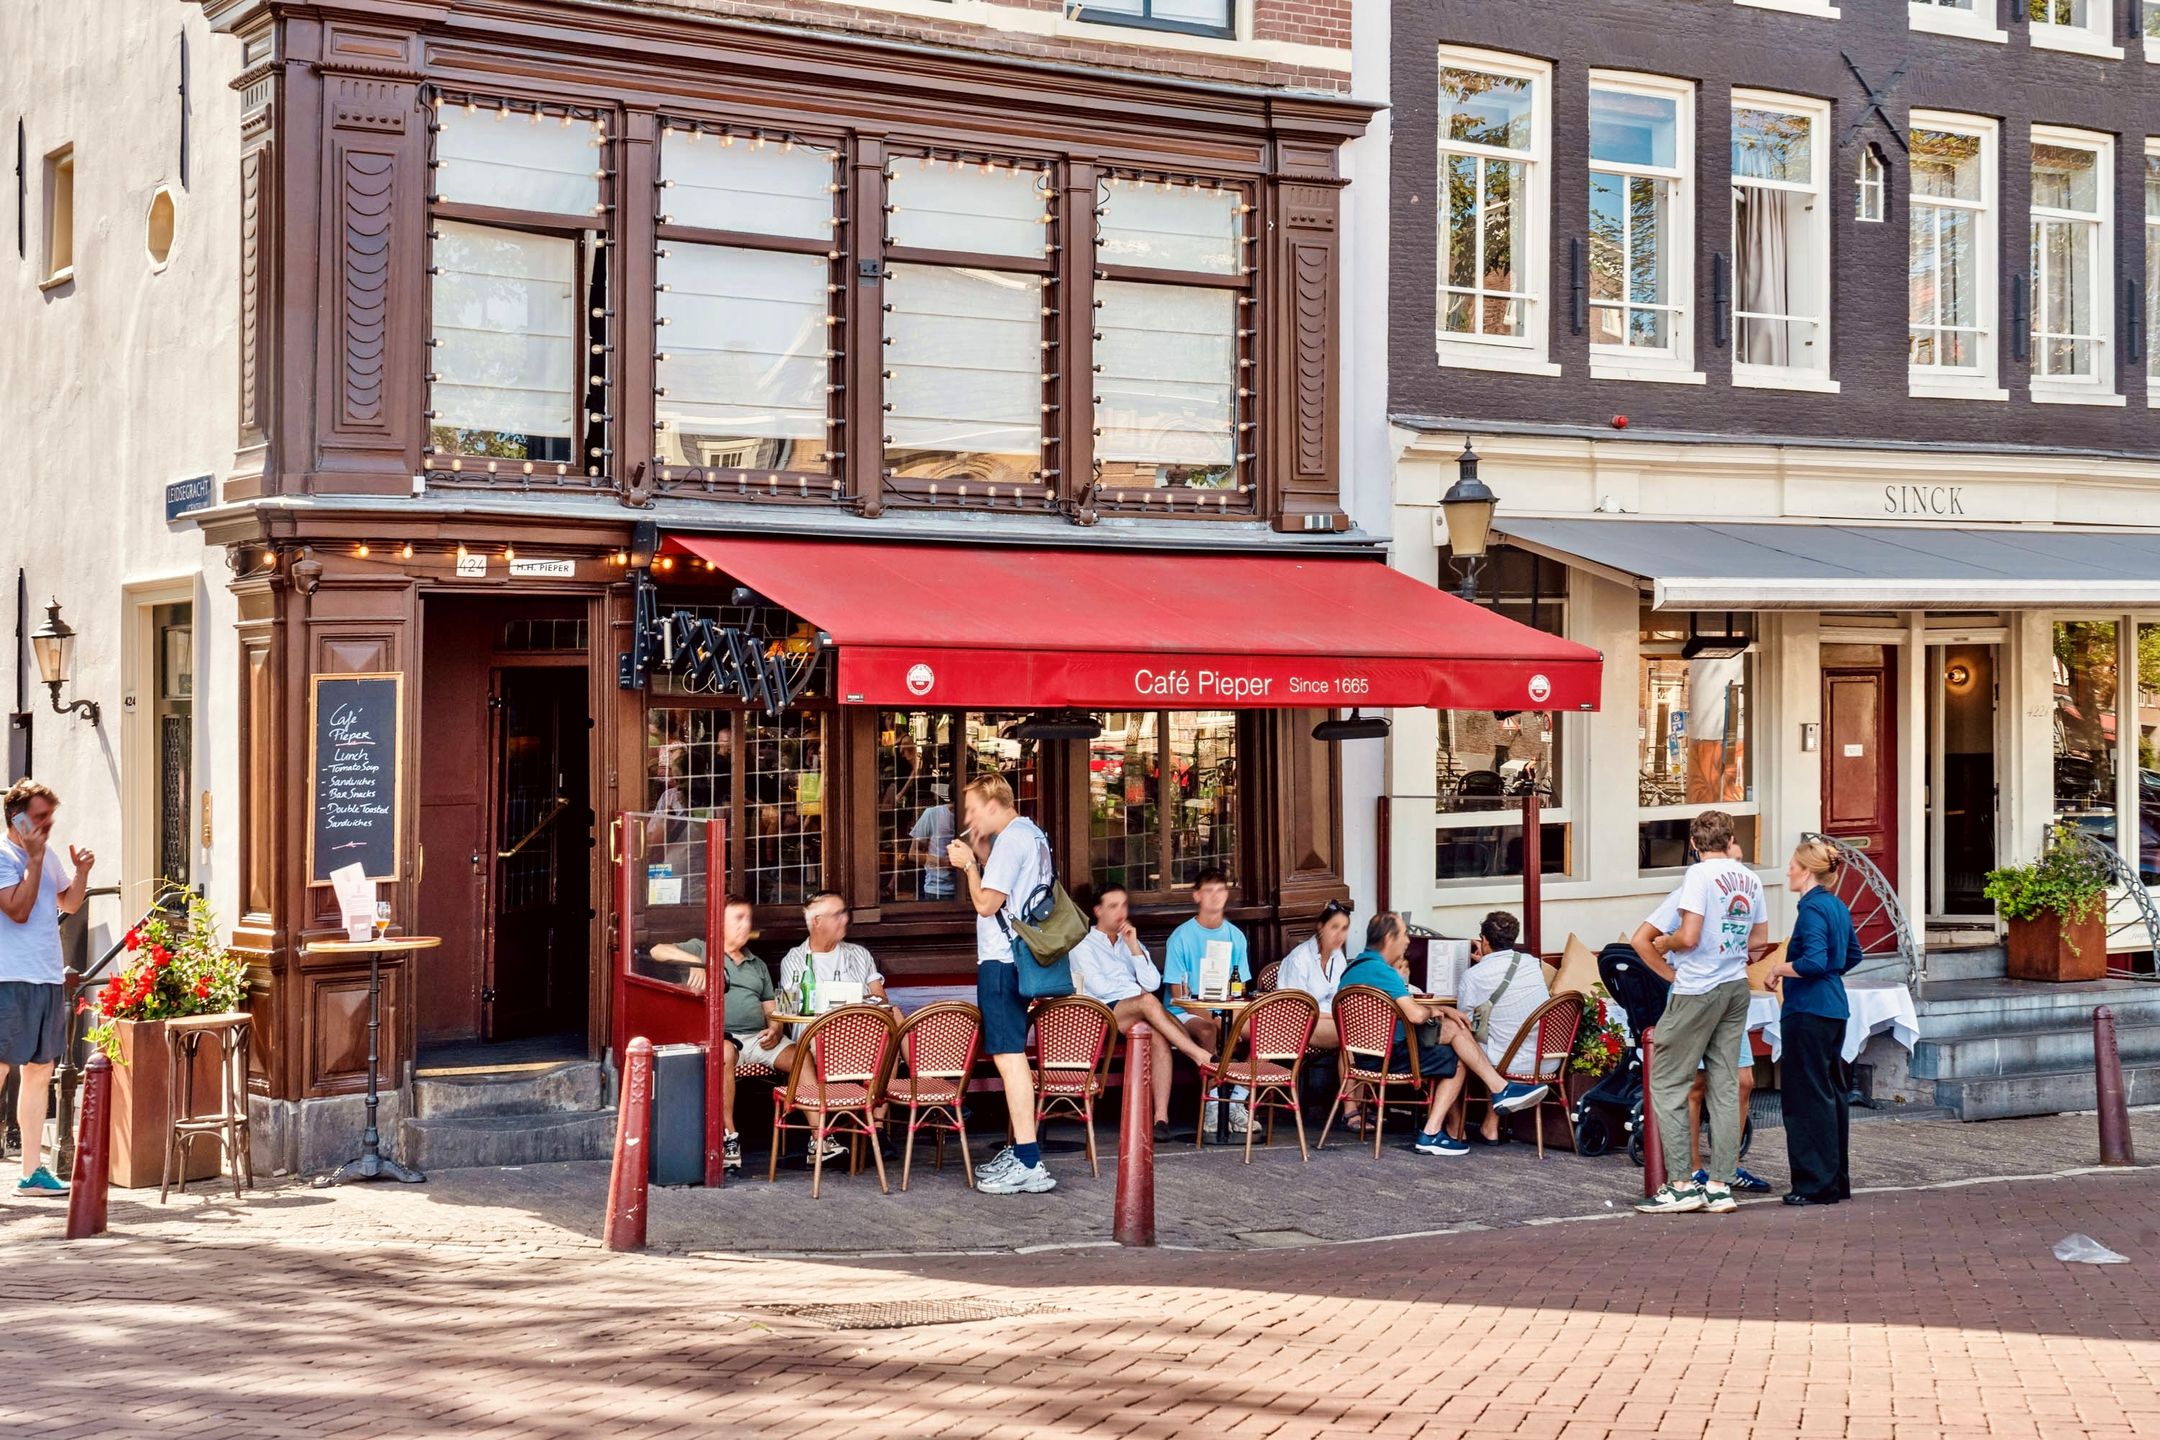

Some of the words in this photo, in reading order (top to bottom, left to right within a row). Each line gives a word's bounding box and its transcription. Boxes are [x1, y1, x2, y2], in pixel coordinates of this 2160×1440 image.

[168, 480, 208, 503] LEIDSEGRACHT
[1884, 485, 1965, 515] SINCK
[459, 558, 484, 573] 424
[539, 563, 570, 572] PIEPER
[1134, 668, 1190, 695] Café
[1198, 670, 1273, 701] Pieper
[1289, 676, 1329, 693] Since
[1333, 677, 1369, 694] 1665
[329, 703, 363, 732] Café
[334, 748, 369, 762] Lunch
[328, 763, 361, 773] Tomato
[360, 761, 380, 773] Soup
[328, 776, 376, 787] Sandwiches
[346, 788, 376, 799] Snacks
[326, 803, 360, 815] Double
[359, 803, 390, 814] Toasted
[325, 815, 373, 829] Sandwiches
[1715, 871, 1758, 900] BOOTHUIS
